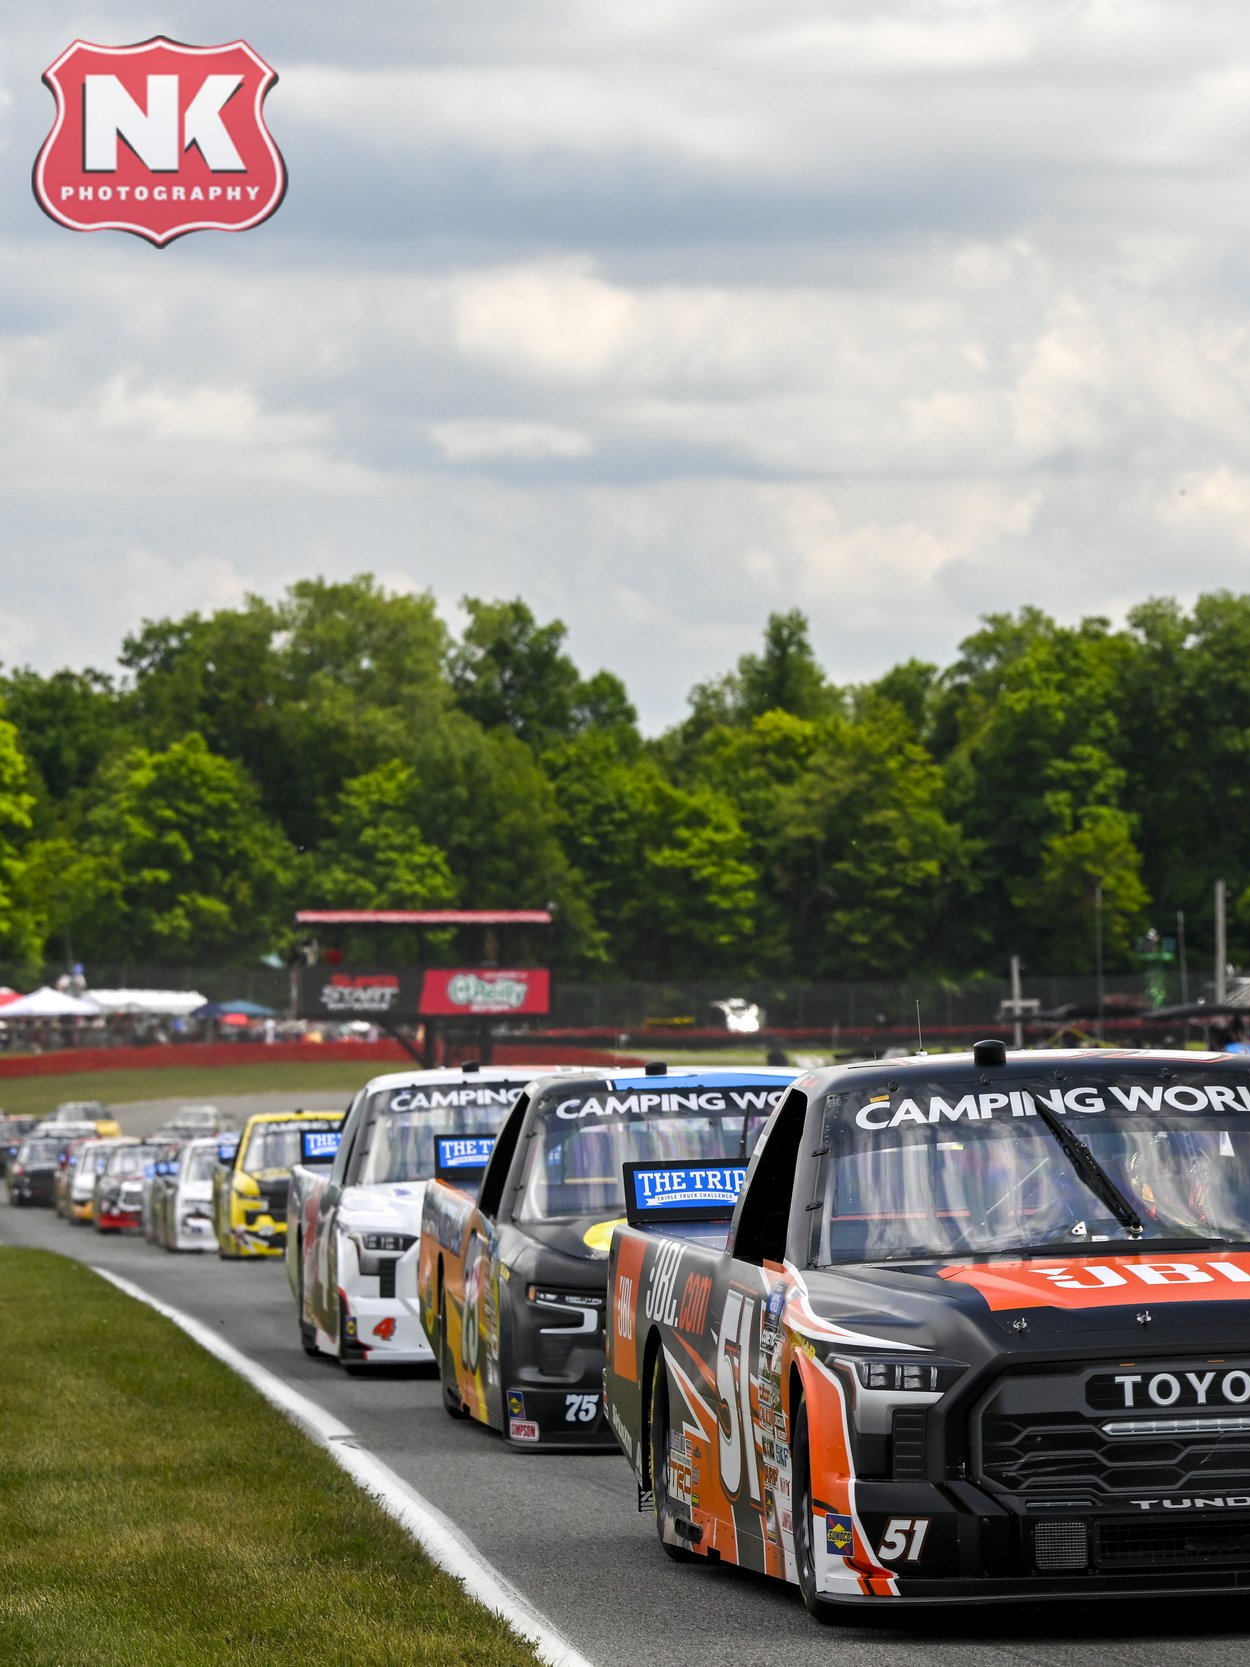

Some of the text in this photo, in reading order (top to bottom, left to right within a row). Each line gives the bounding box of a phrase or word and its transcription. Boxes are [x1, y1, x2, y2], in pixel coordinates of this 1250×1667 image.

[556, 1093, 727, 1119] CAMPING
[855, 1087, 1104, 1130] CAMPING
[441, 1140, 477, 1159] THE
[638, 1171, 687, 1196] THE
[617, 1275, 633, 1341] JBL
[373, 1317, 397, 1341] 4
[565, 1393, 600, 1422] 75
[716, 1288, 761, 1502] 51
[511, 1422, 536, 1438] SIMPSON
[827, 1530, 852, 1543] SUNOCO
[878, 1519, 930, 1560] 51
